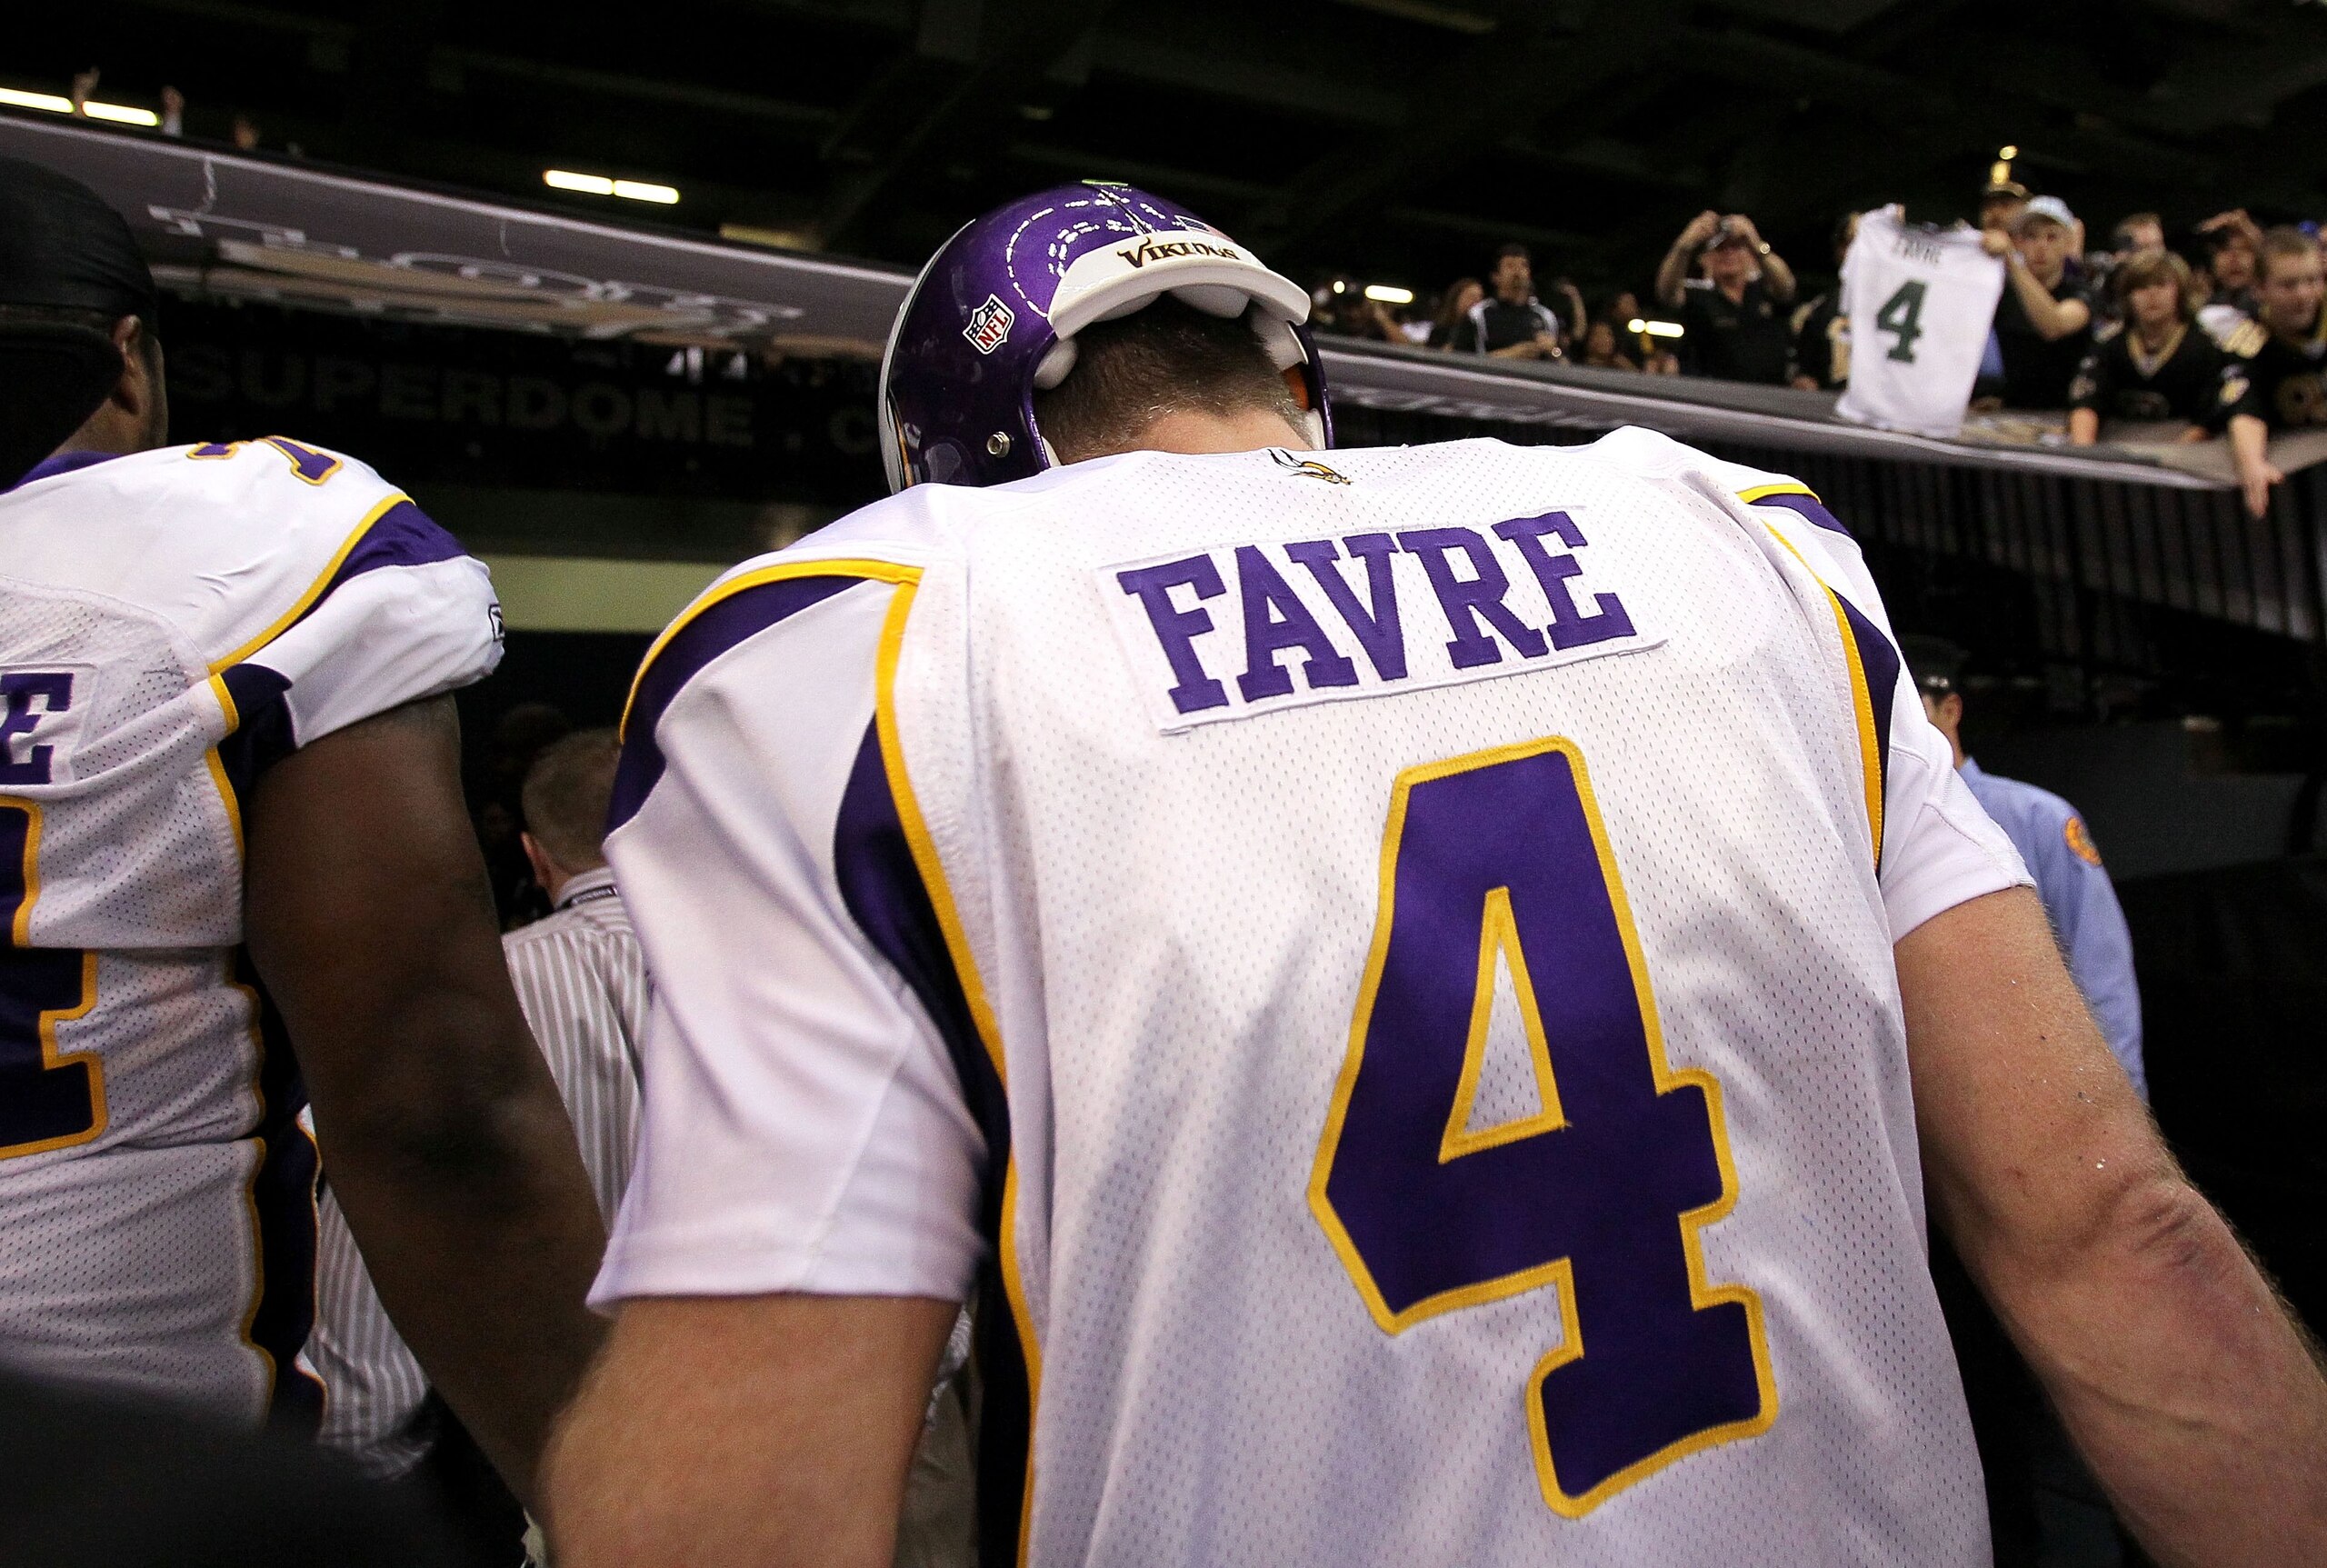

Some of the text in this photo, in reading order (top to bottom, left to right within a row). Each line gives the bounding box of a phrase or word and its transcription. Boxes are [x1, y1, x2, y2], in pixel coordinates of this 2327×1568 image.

[976, 313, 1009, 349] NFL
[1875, 280, 1928, 365] 4
[165, 340, 757, 449] SUPERDOME
[1116, 510, 1637, 715] FAVRE
[1306, 734, 1779, 1520] 4
